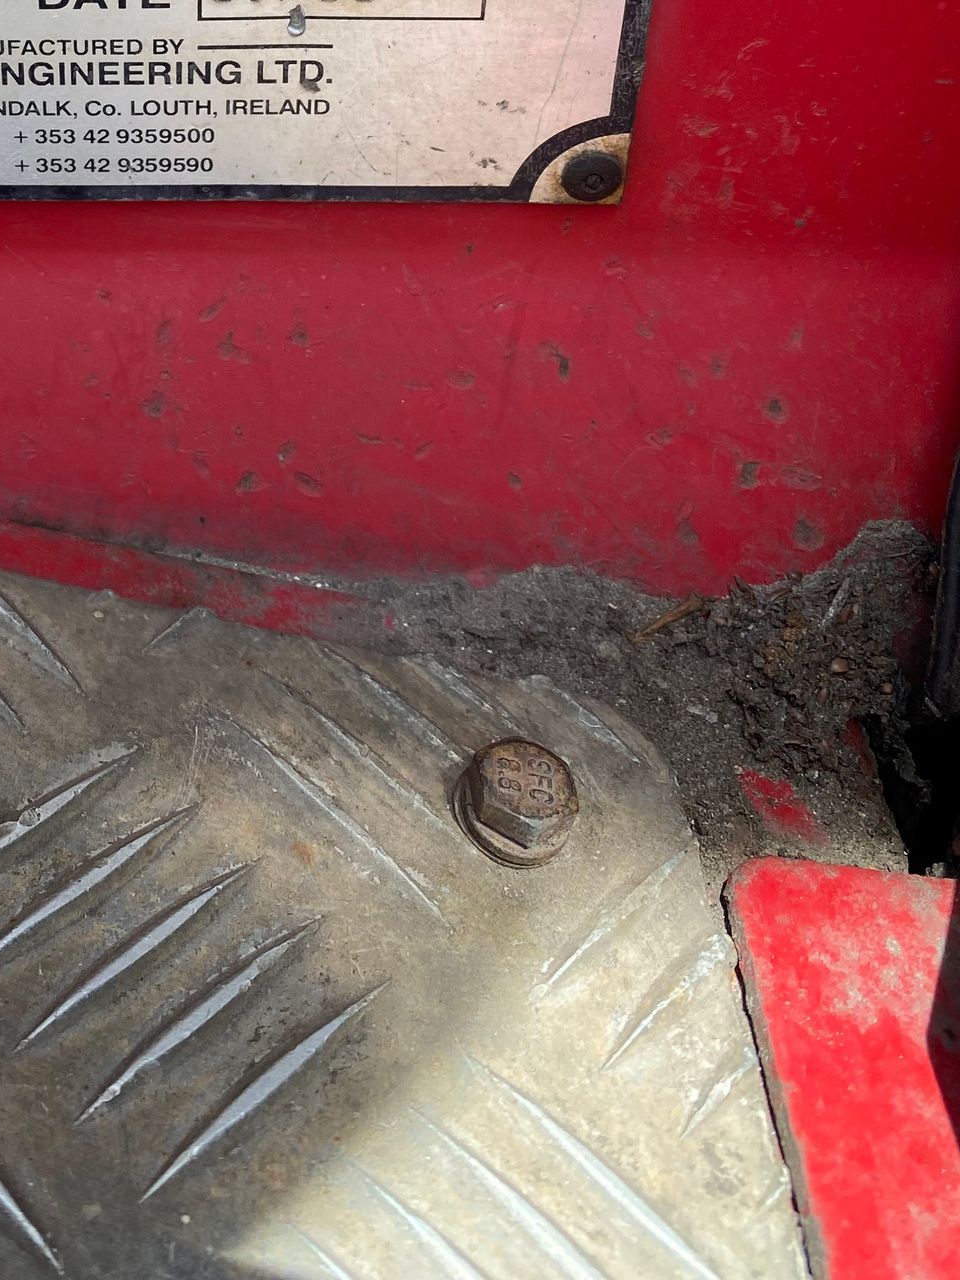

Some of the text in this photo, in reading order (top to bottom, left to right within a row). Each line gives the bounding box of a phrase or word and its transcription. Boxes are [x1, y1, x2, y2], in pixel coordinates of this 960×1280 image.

[153, 39, 184, 55] BY
[256, 60, 333, 84] LTD.
[84, 100, 122, 117] Co.
[131, 99, 217, 118] LOUTH,
[225, 99, 330, 116] IRELAND
[83, 128, 110, 144] 42
[117, 128, 215, 144] 9359500
[84, 157, 110, 173] 42
[118, 156, 213, 173] 9359590
